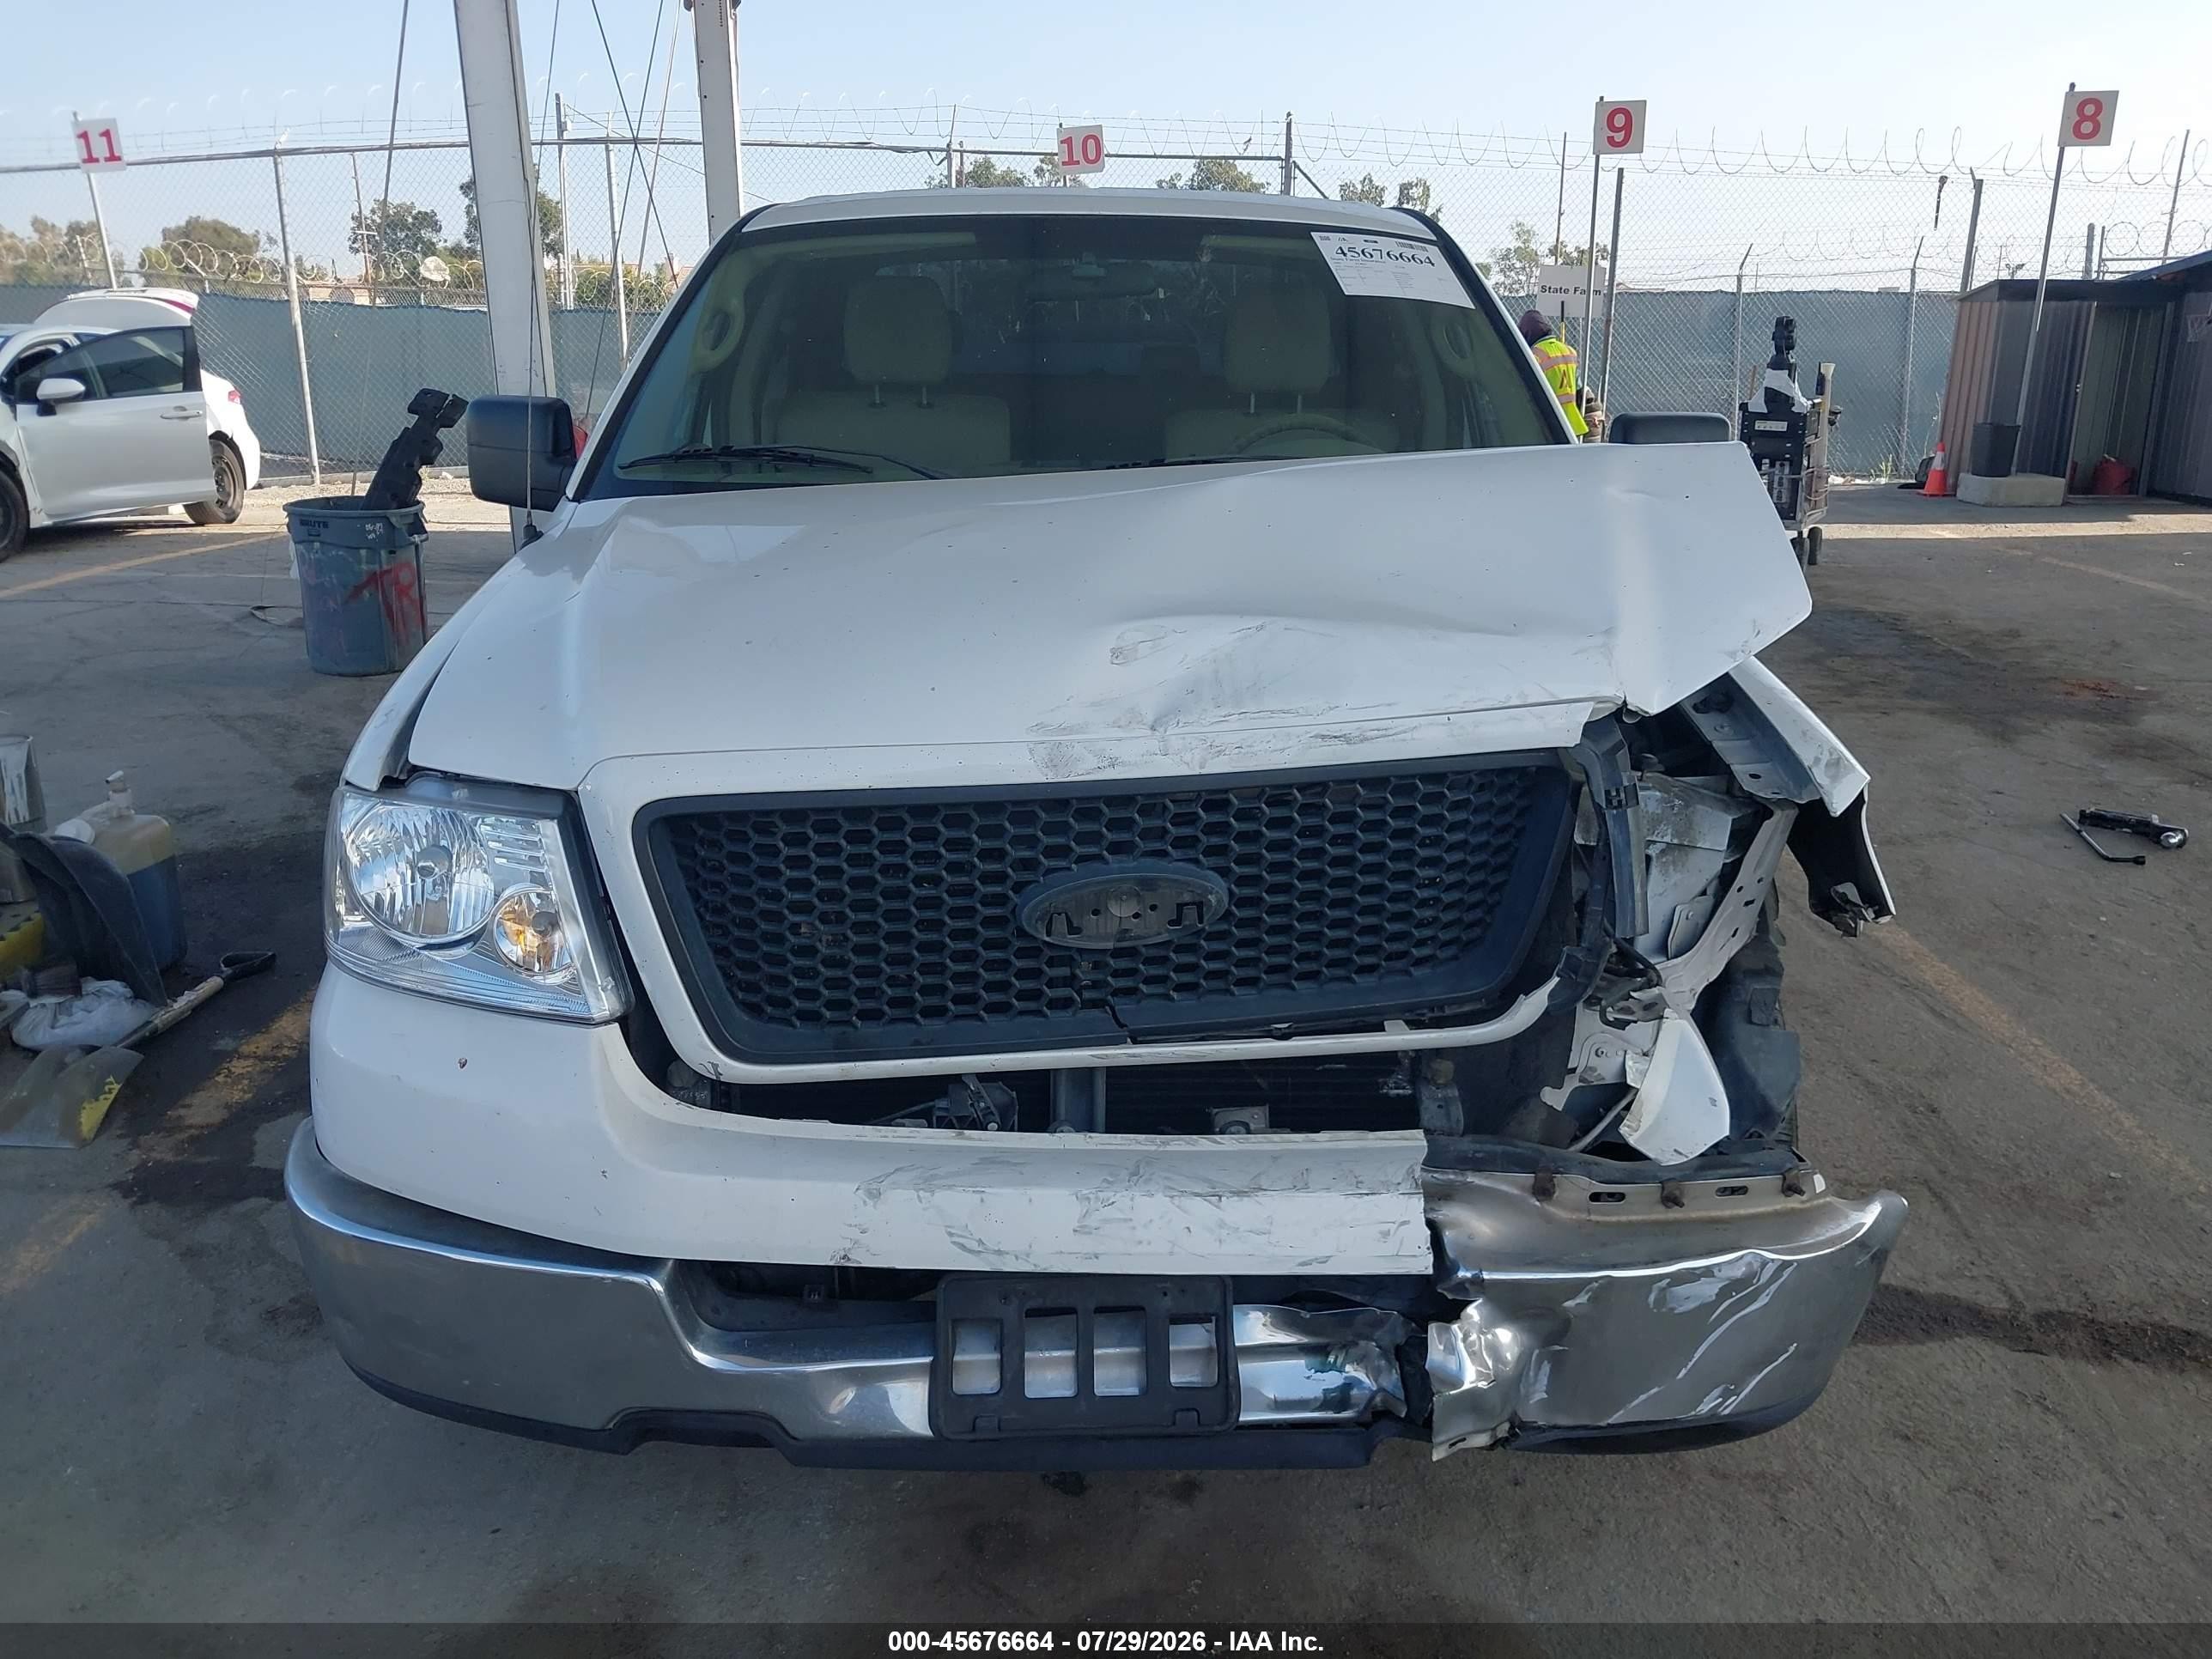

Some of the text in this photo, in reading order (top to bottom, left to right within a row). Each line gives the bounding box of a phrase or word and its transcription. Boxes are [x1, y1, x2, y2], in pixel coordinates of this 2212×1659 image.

[1606, 106, 1633, 149] 9
[2072, 97, 2104, 141] 8
[76, 128, 122, 165] 11
[1060, 134, 1102, 167] 10
[1335, 246, 1436, 268] 45676664
[1540, 284, 1601, 296] State Fam
